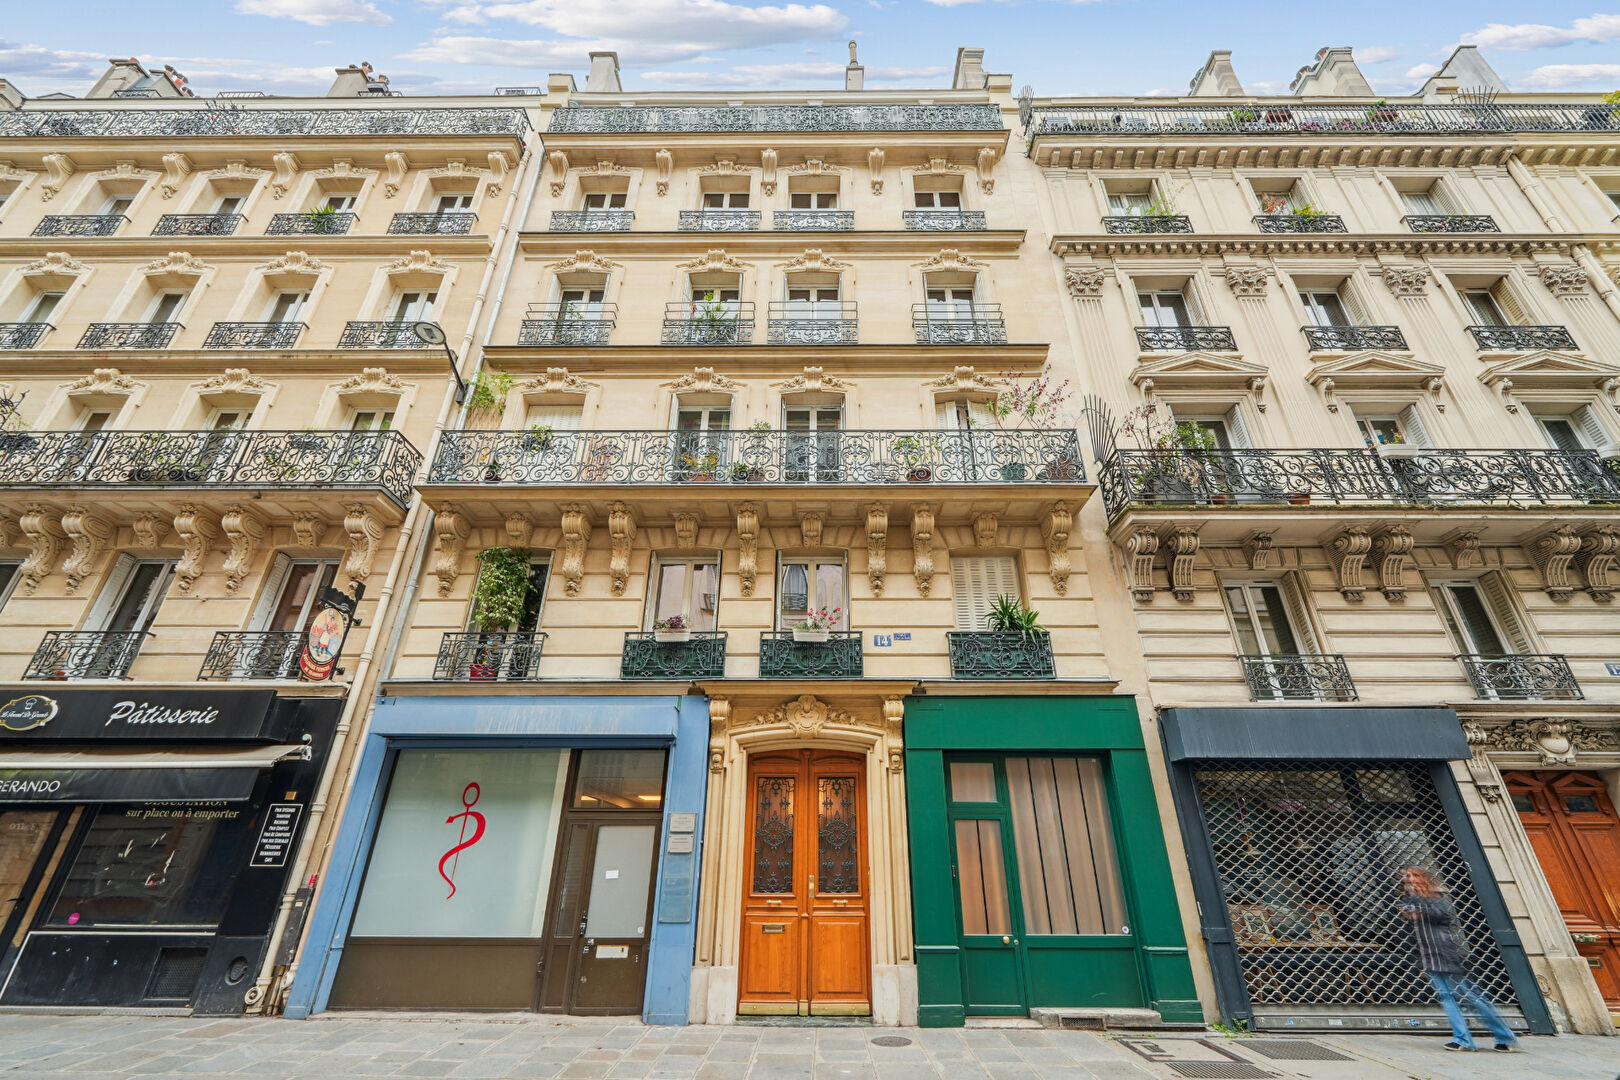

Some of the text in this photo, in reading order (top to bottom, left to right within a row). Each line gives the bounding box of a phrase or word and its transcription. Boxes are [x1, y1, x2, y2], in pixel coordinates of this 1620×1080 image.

[877, 635, 889, 646] 14
[105, 701, 219, 726] Pâtisserie
[125, 809, 143, 817] sur
[143, 808, 170, 820] place
[185, 808, 192, 817] à
[193, 809, 240, 820] emporter
